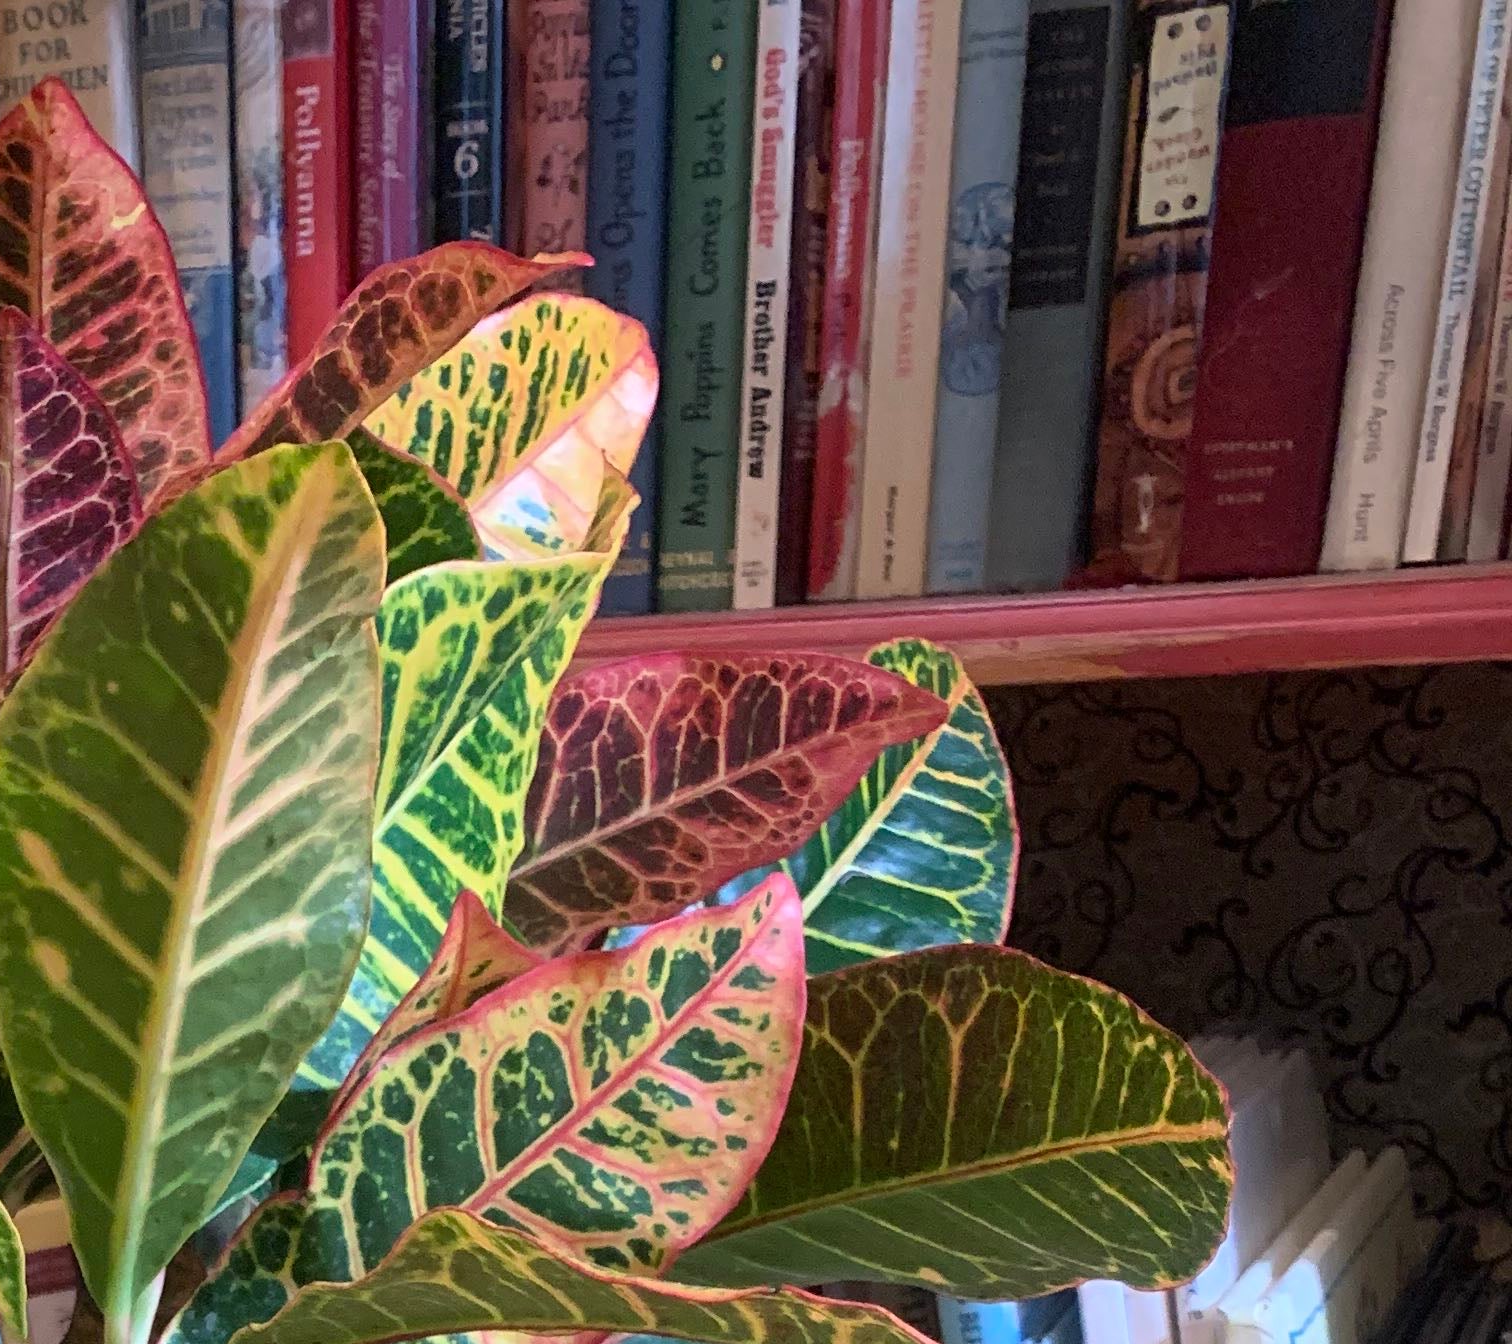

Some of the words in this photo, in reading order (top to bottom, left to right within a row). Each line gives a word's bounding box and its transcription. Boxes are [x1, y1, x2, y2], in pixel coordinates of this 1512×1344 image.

[2, 0, 89, 35] BOOK
[19, 38, 71, 63] FOR
[603, 0, 640, 77] Door
[602, 91, 635, 138] the
[762, 47, 787, 135] God's
[294, 84, 321, 257] Pollyanna
[454, 140, 480, 179] 6
[690, 97, 724, 180] Back
[600, 152, 644, 249] Opens
[756, 141, 784, 250] Smuggler
[1445, 165, 1486, 301] COTTONTAIL
[688, 196, 721, 296] Comes
[747, 279, 778, 378] Brother
[1376, 283, 1406, 355] Across
[681, 320, 723, 423] Poppins
[1370, 358, 1398, 399] Five
[747, 386, 774, 481] Andrew
[1362, 406, 1391, 466] Aprils
[680, 447, 720, 528] Mary
[1352, 491, 1378, 543] Hunt
